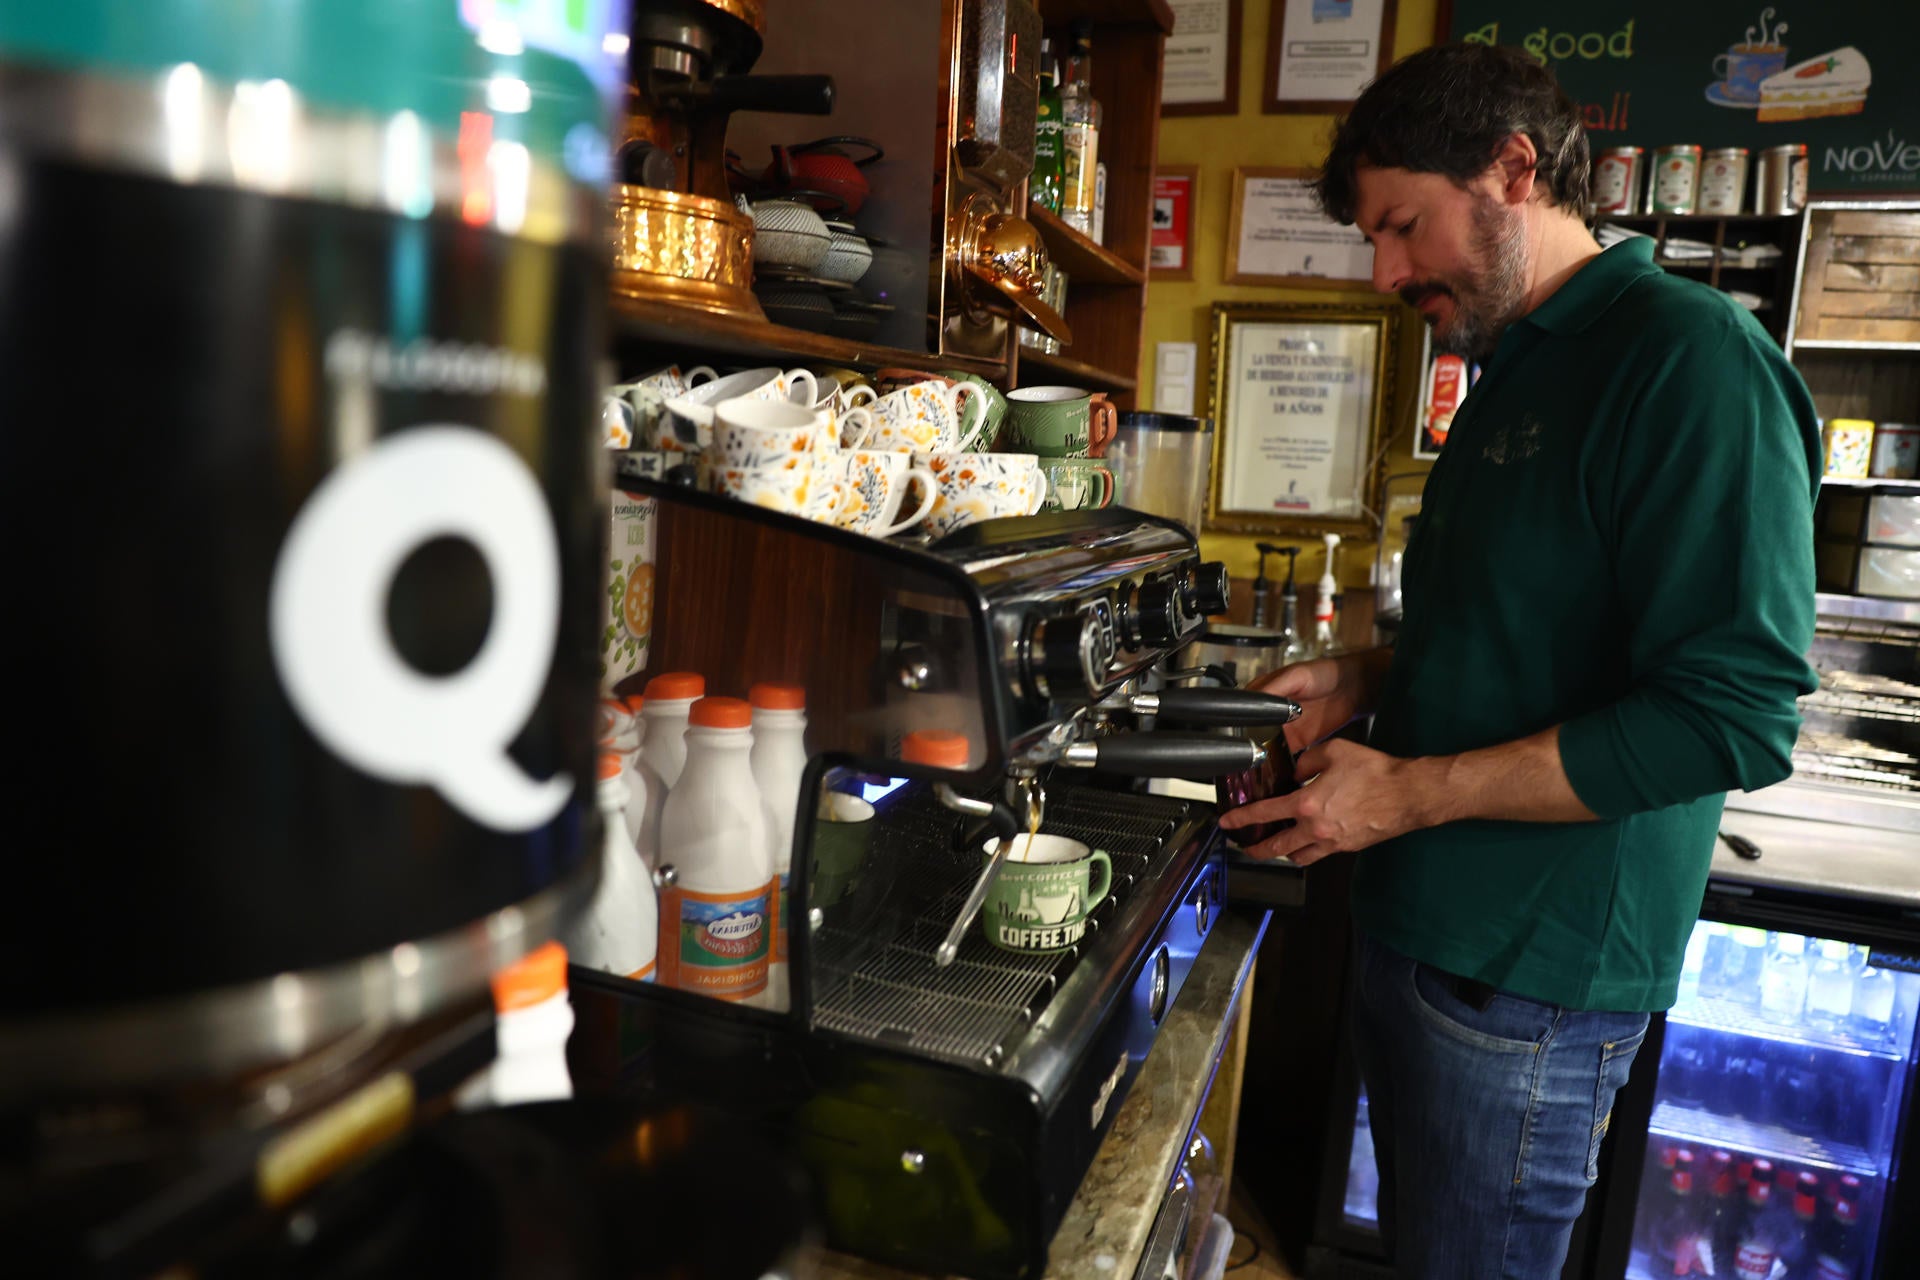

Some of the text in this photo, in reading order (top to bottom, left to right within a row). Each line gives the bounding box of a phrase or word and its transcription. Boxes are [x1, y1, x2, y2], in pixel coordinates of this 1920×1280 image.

[1523, 18, 1635, 65] good
[269, 423, 575, 833] Q
[1027, 871, 1073, 883] COFFEE
